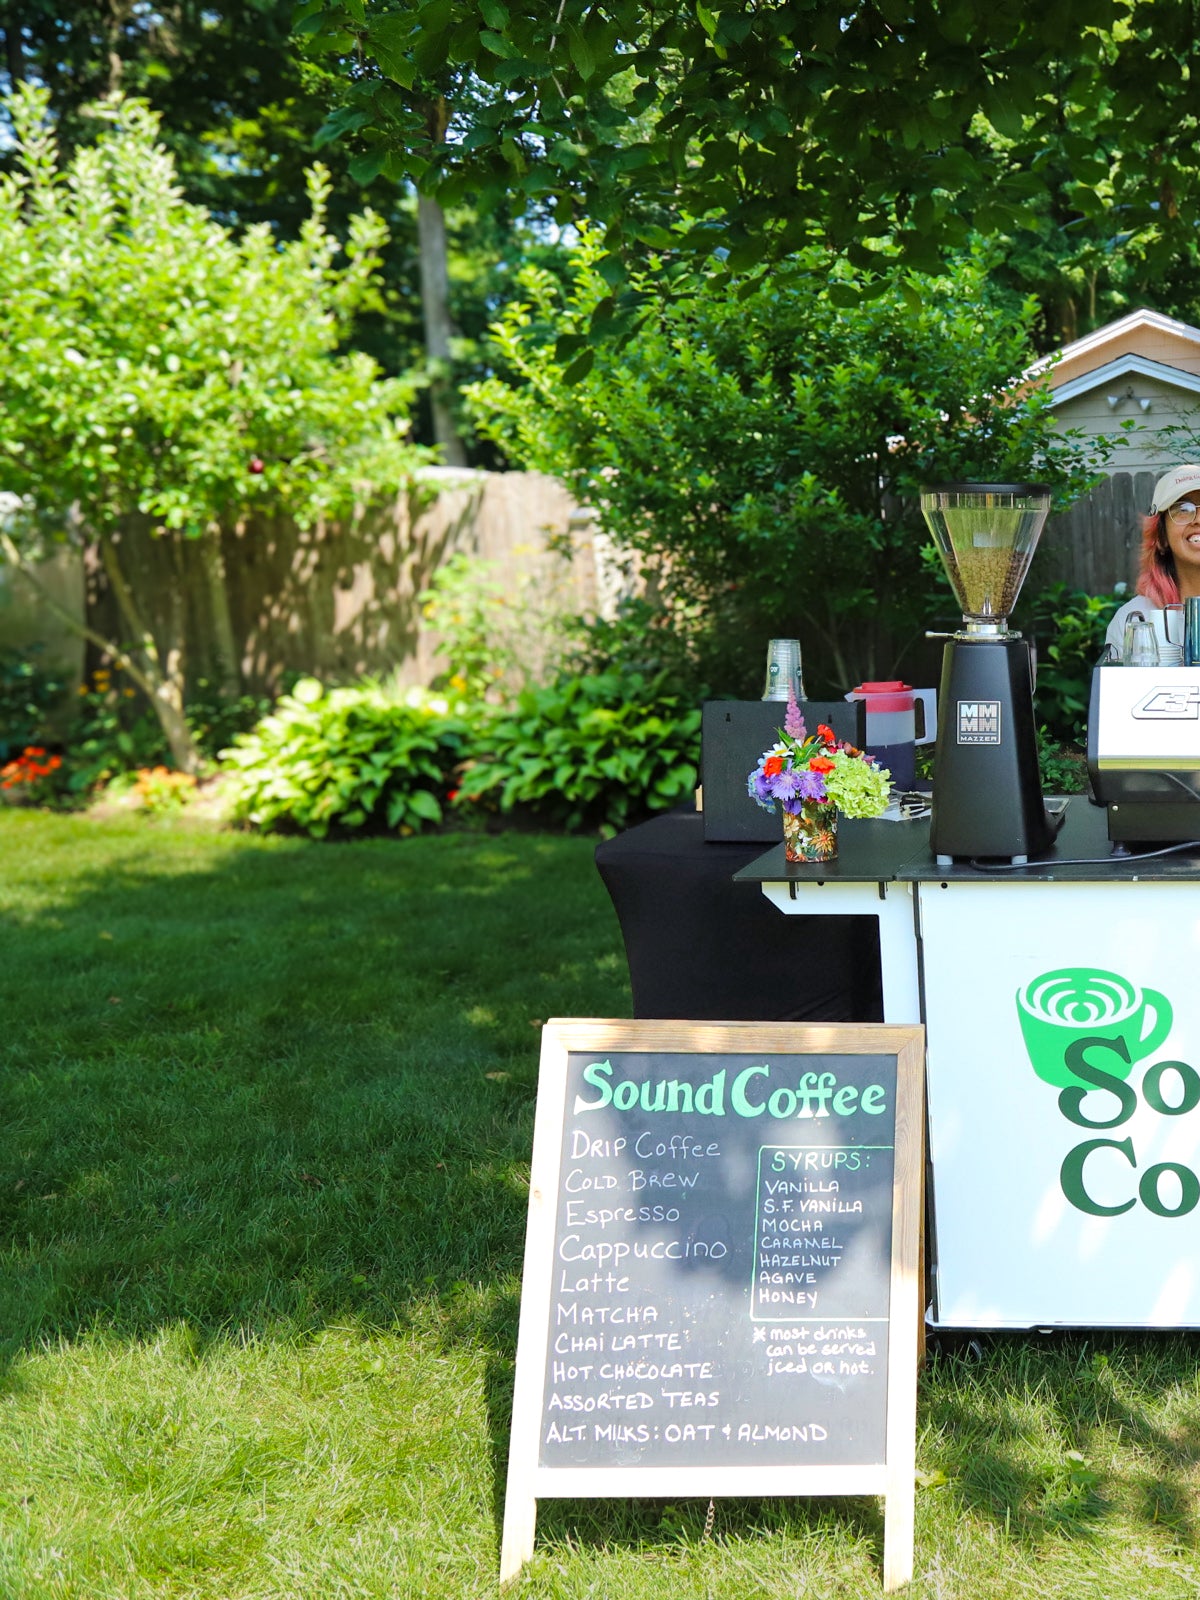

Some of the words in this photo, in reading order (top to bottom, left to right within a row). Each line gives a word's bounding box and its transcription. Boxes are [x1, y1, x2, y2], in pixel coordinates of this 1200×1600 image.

[574, 1059, 726, 1116] Sound
[731, 1064, 886, 1119] Coffee
[635, 1132, 721, 1158] Coffee
[771, 1151, 870, 1172] SYRUPS:
[566, 1200, 679, 1229] Espresso
[764, 1198, 793, 1214] S.F.
[763, 1219, 823, 1232] MOCHA
[559, 1235, 727, 1268] Cappuccino
[761, 1236, 843, 1249] CARAMEL
[760, 1255, 841, 1267] HAZELNUT
[560, 1271, 629, 1293] Latte
[760, 1271, 816, 1283] AGAVE
[759, 1289, 818, 1308] HONEY
[557, 1303, 658, 1325] MATCHA
[611, 1333, 681, 1350] LATTE
[770, 1326, 810, 1341] most
[814, 1328, 866, 1340] drinks
[766, 1344, 793, 1357] can
[797, 1342, 816, 1355] be
[822, 1341, 876, 1356] served
[553, 1362, 592, 1382] HOT
[601, 1363, 713, 1379] CHOCOLATE
[549, 1392, 653, 1412] ASSORTED
[665, 1391, 719, 1408] TEAS
[546, 1422, 586, 1443] ALT.
[596, 1425, 659, 1442] MILKS:
[665, 1425, 714, 1441] OAT
[738, 1424, 827, 1442] ALMOND
